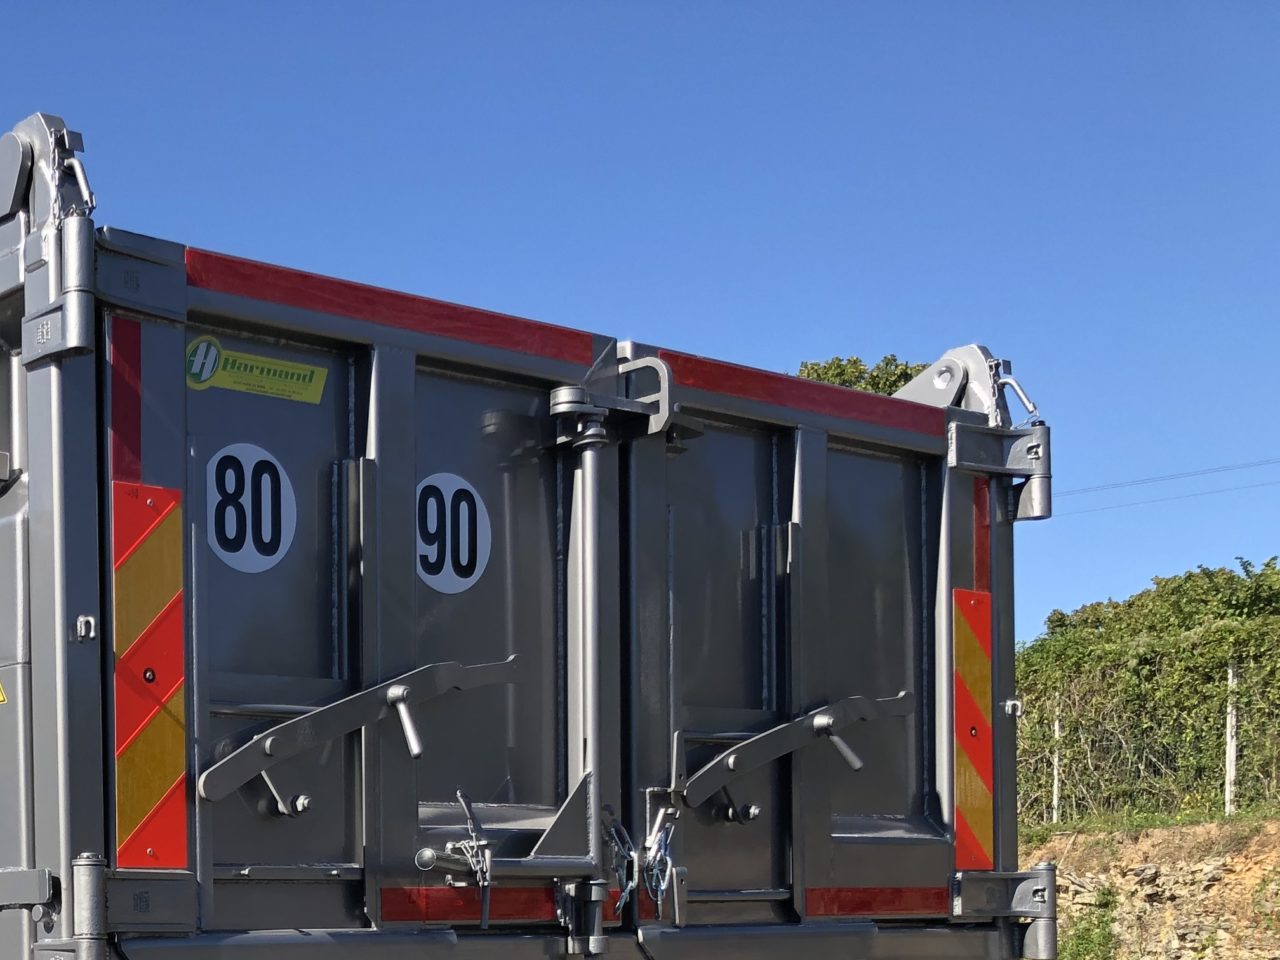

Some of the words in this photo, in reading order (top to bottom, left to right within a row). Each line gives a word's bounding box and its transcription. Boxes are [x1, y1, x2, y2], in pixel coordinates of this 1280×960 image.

[221, 357, 315, 384] Harmand
[214, 454, 282, 557] 80
[417, 484, 478, 579] 90
